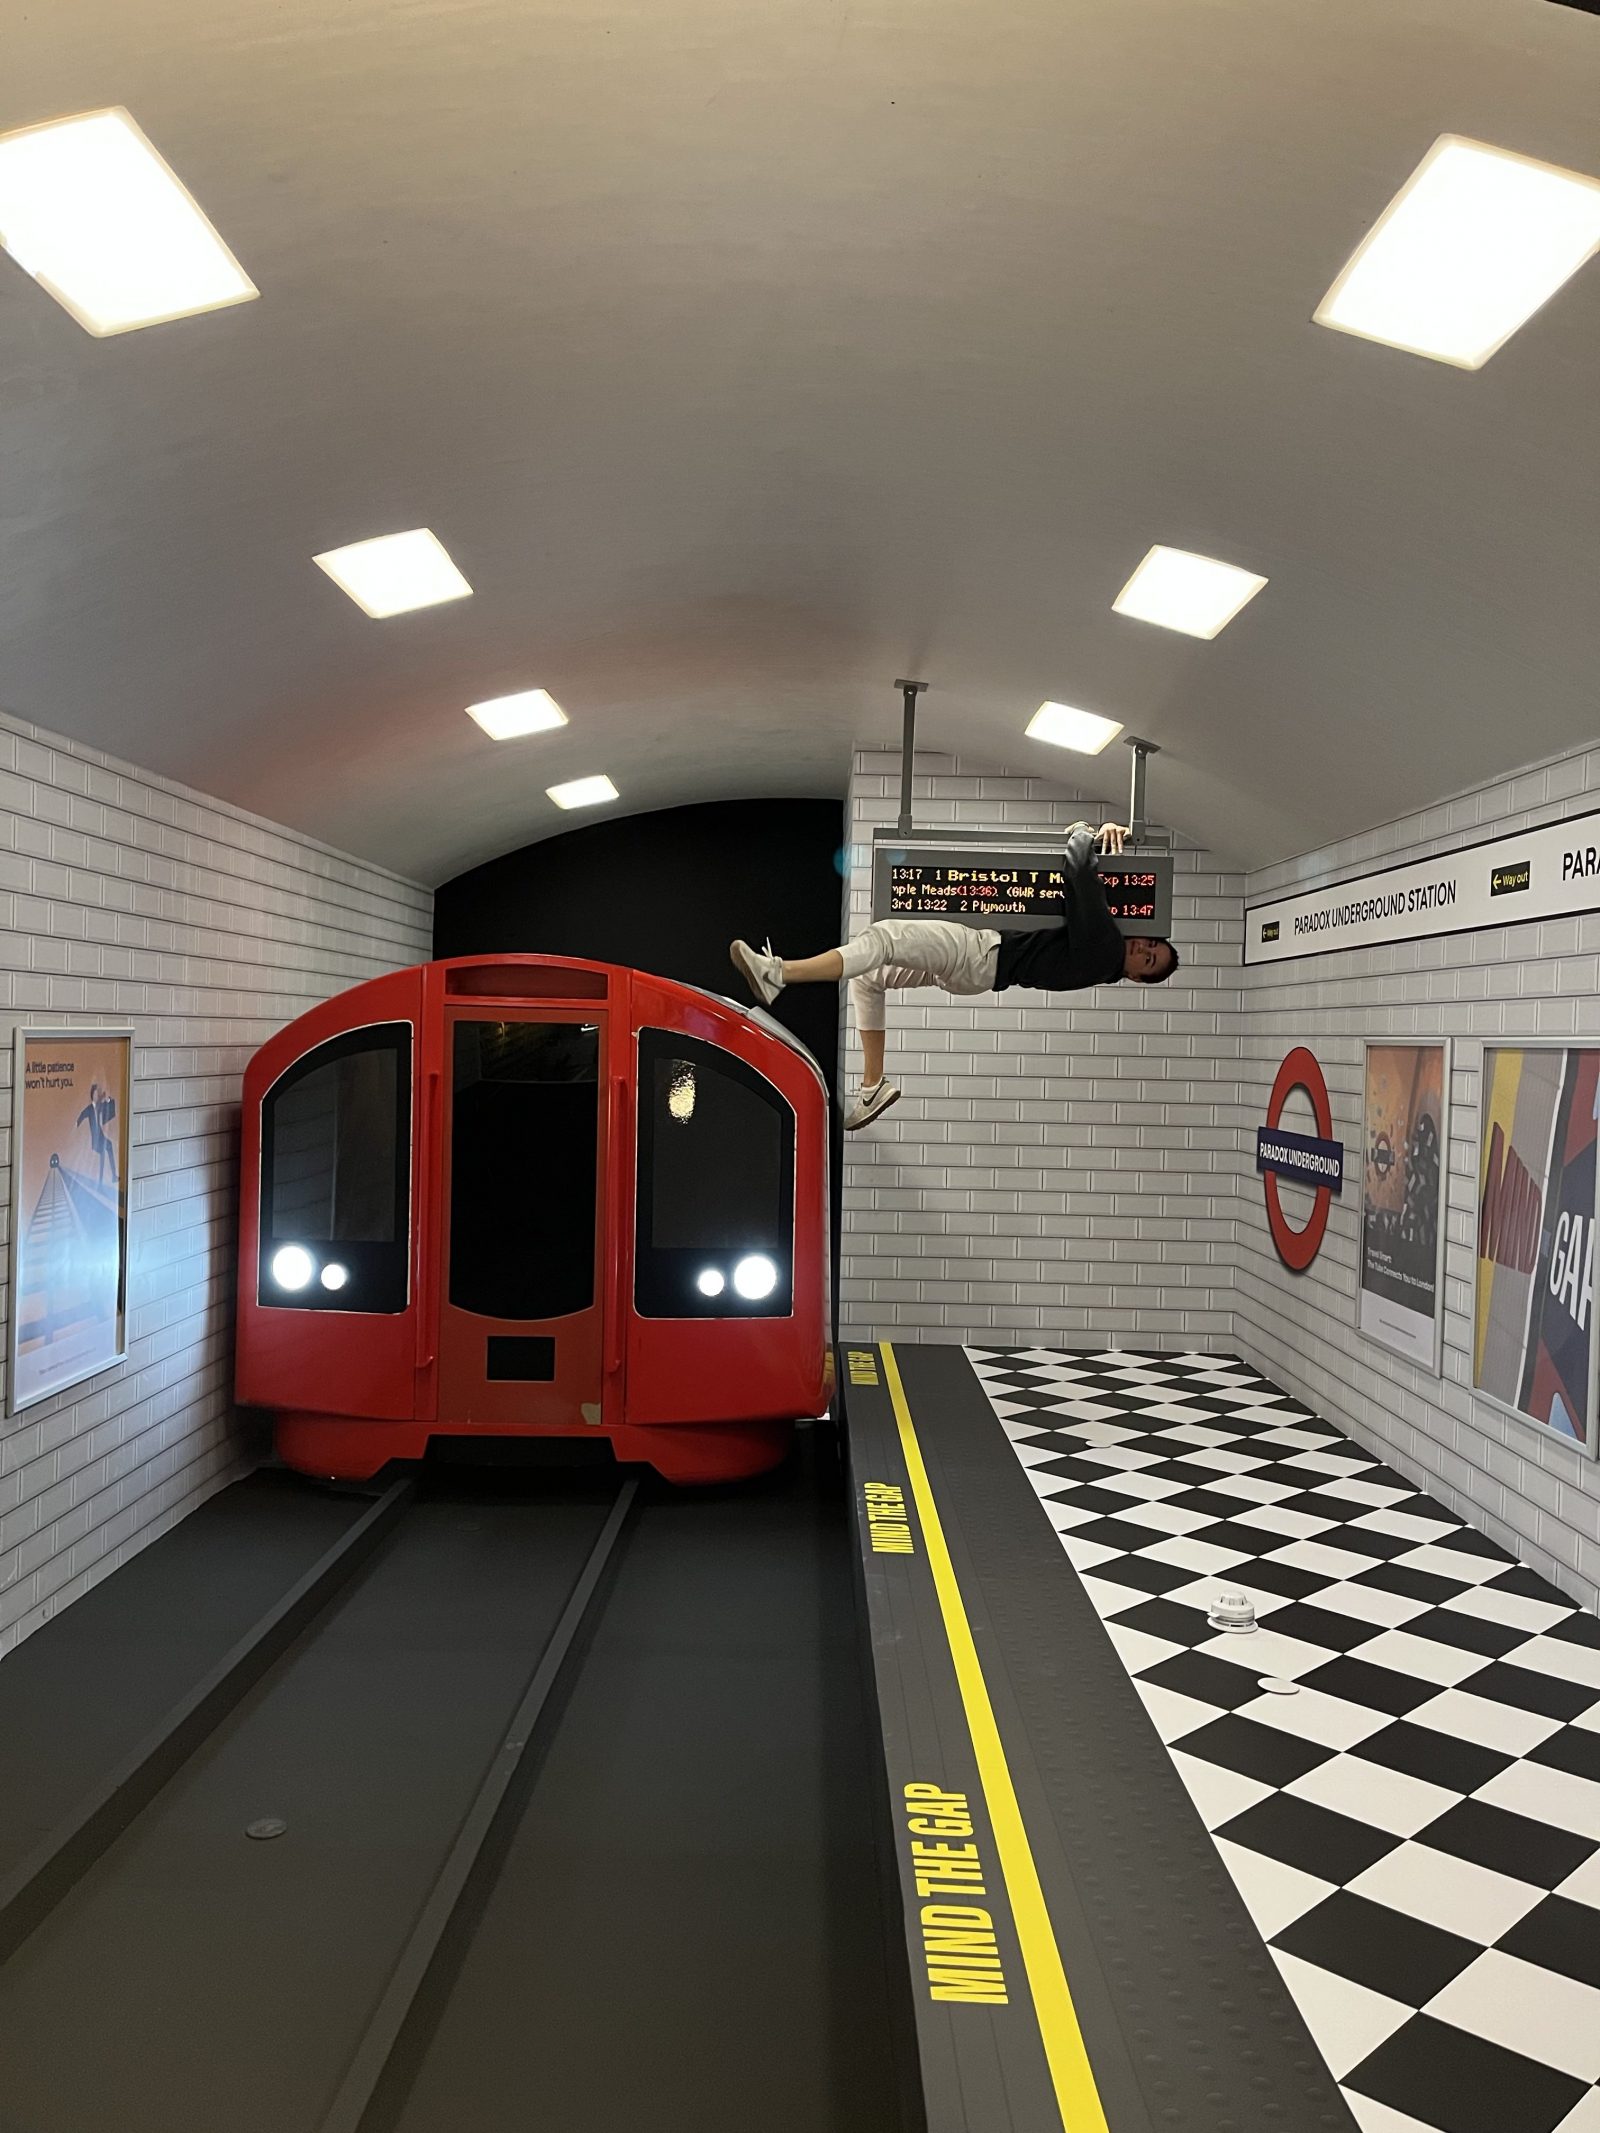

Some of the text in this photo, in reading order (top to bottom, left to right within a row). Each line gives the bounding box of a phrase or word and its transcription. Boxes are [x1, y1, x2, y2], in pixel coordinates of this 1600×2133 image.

[892, 868, 923, 880] 13:17
[936, 870, 941, 880] 1
[947, 869, 1018, 883] Bristol
[1029, 871, 1039, 884] T
[1097, 873, 1119, 888] xp
[1124, 875, 1154, 886] 13:25
[1563, 846, 1600, 881] PAR
[891, 898, 1026, 914] 3rd 13:22 2 Plymouth
[1122, 904, 1154, 916] 13:47
[1294, 879, 1457, 936] PARADOX UNDERGROUND STATION
[1260, 1142, 1340, 1177] PARADOX UNDERGROUND
[863, 1482, 915, 1554] MIND THE GAP
[903, 1782, 1009, 2005] MIND THE GAP
